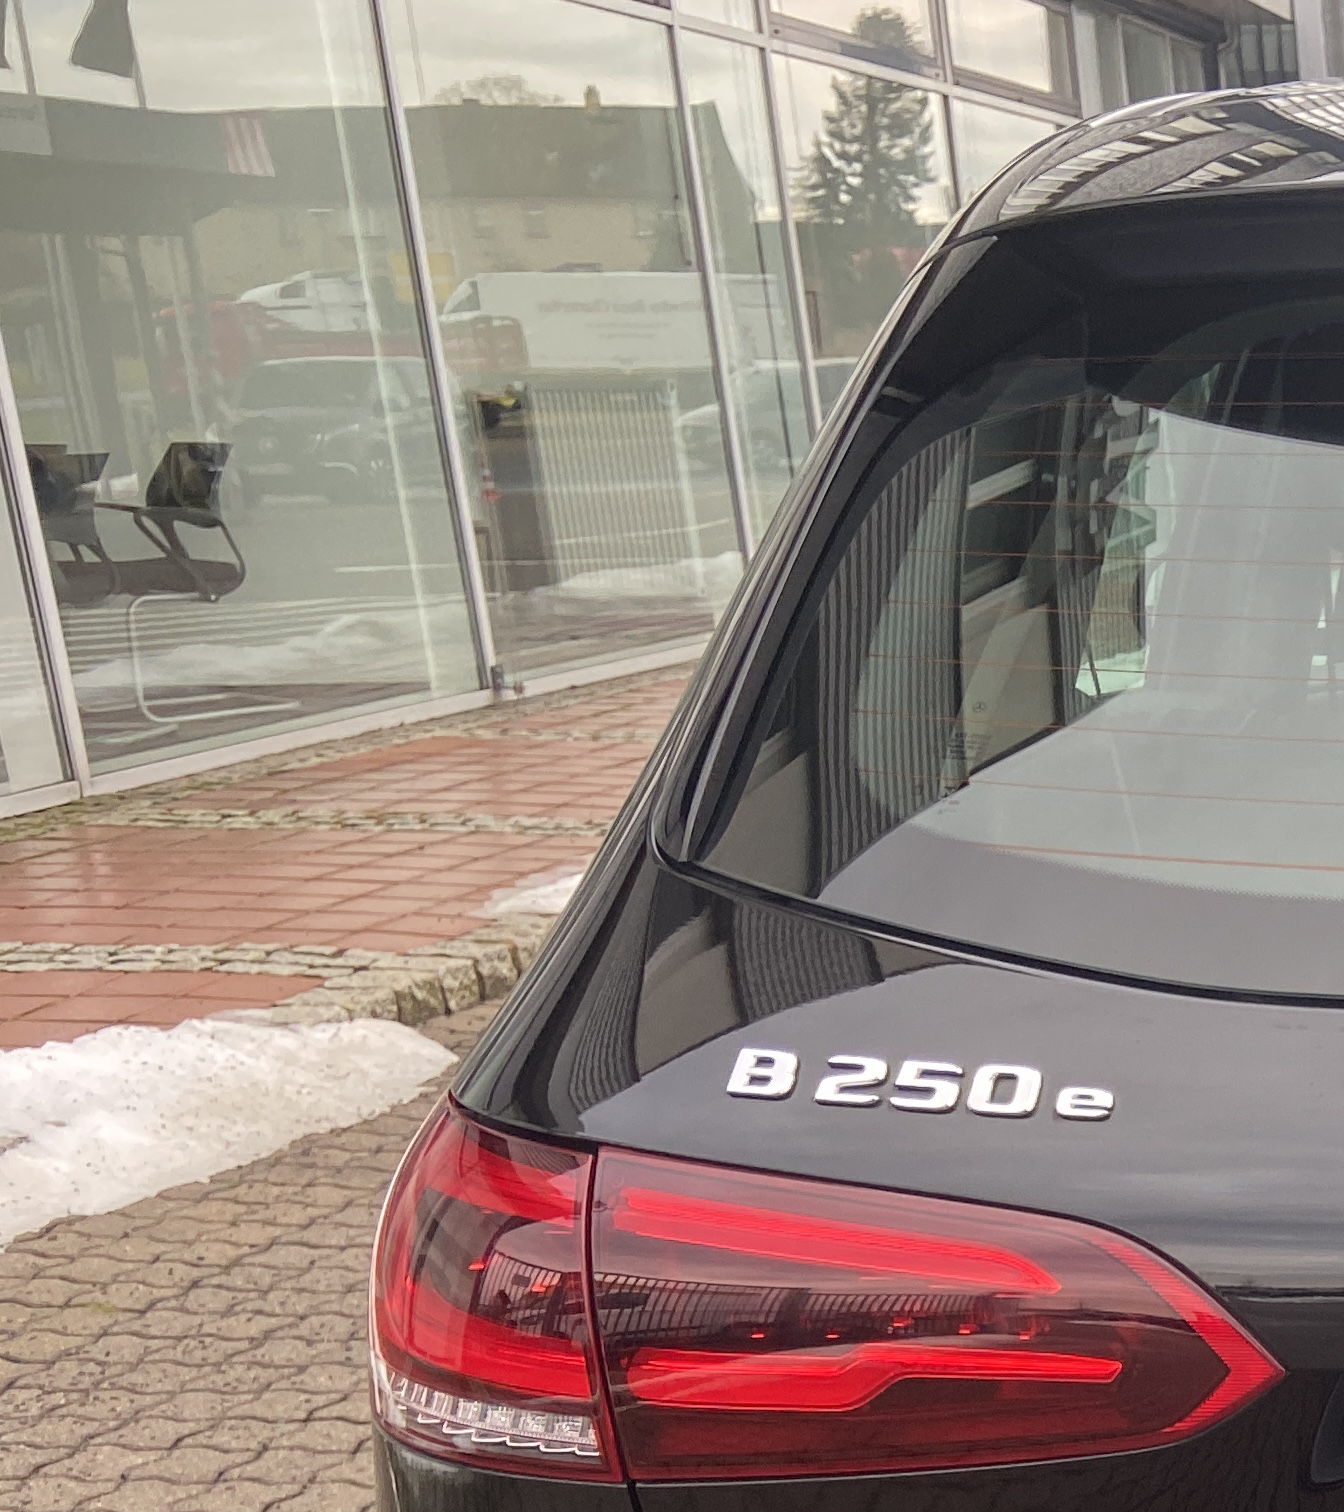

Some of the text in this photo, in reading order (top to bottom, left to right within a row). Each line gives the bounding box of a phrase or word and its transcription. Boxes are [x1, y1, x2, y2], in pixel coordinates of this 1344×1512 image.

[726, 1047, 1115, 1121] B 250 e
